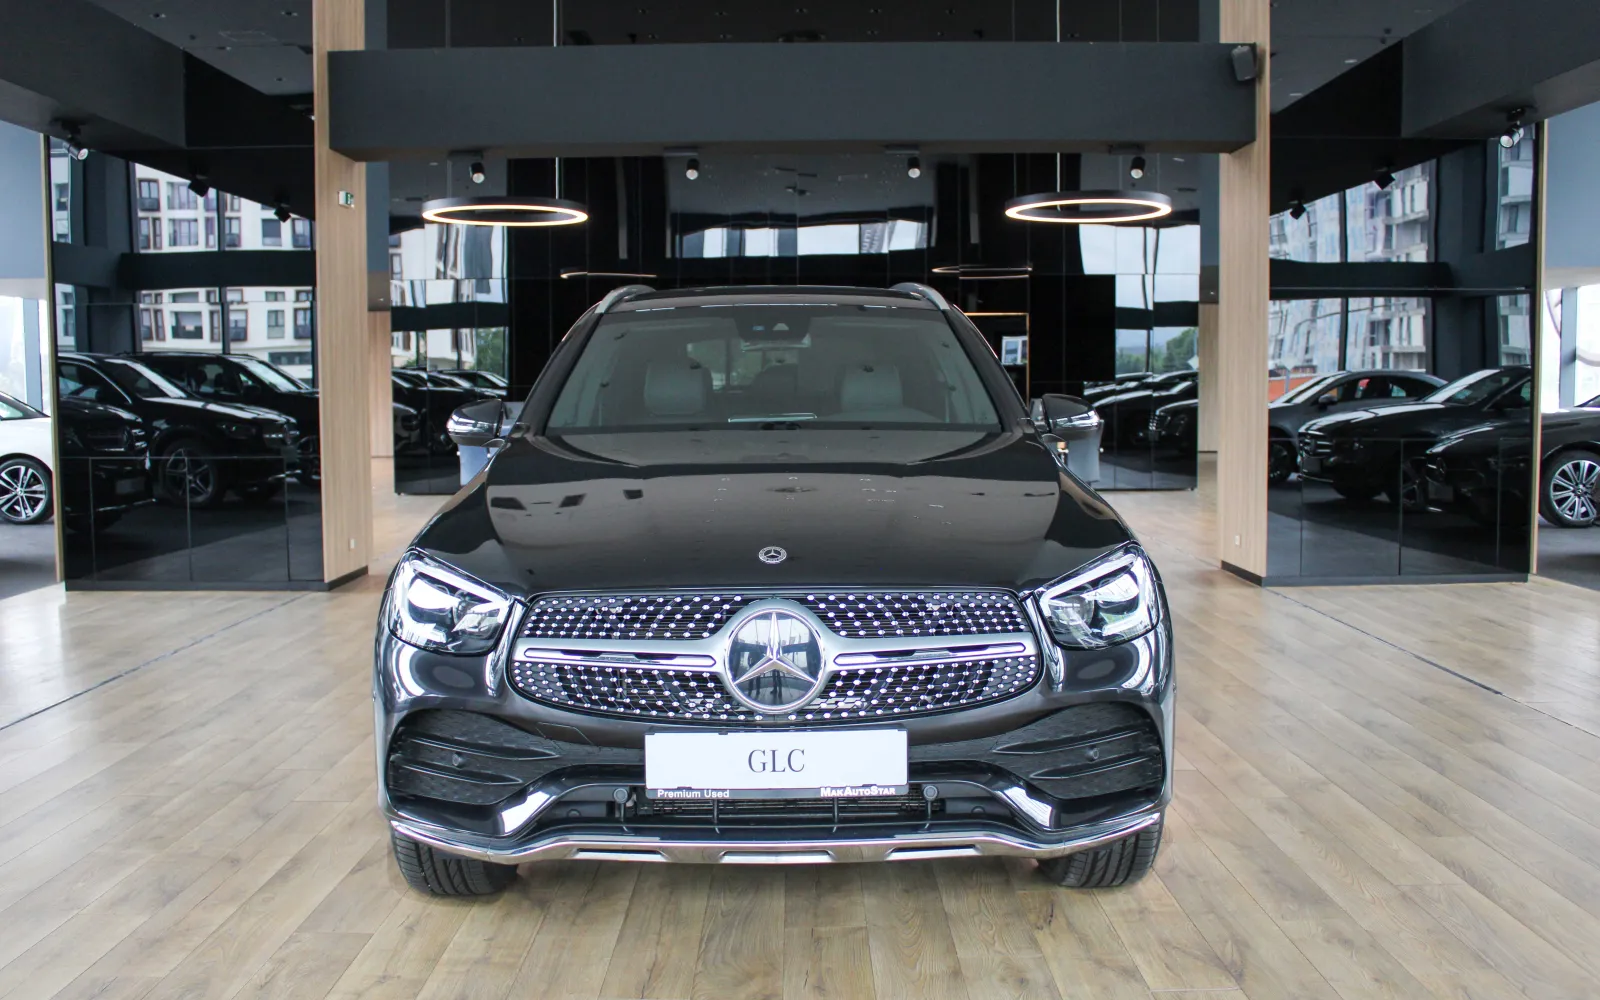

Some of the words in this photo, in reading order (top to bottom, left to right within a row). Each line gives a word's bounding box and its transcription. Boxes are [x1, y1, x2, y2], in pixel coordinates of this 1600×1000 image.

[748, 748, 805, 773] GLC
[657, 789, 701, 798] Premium
[703, 789, 730, 798] Used
